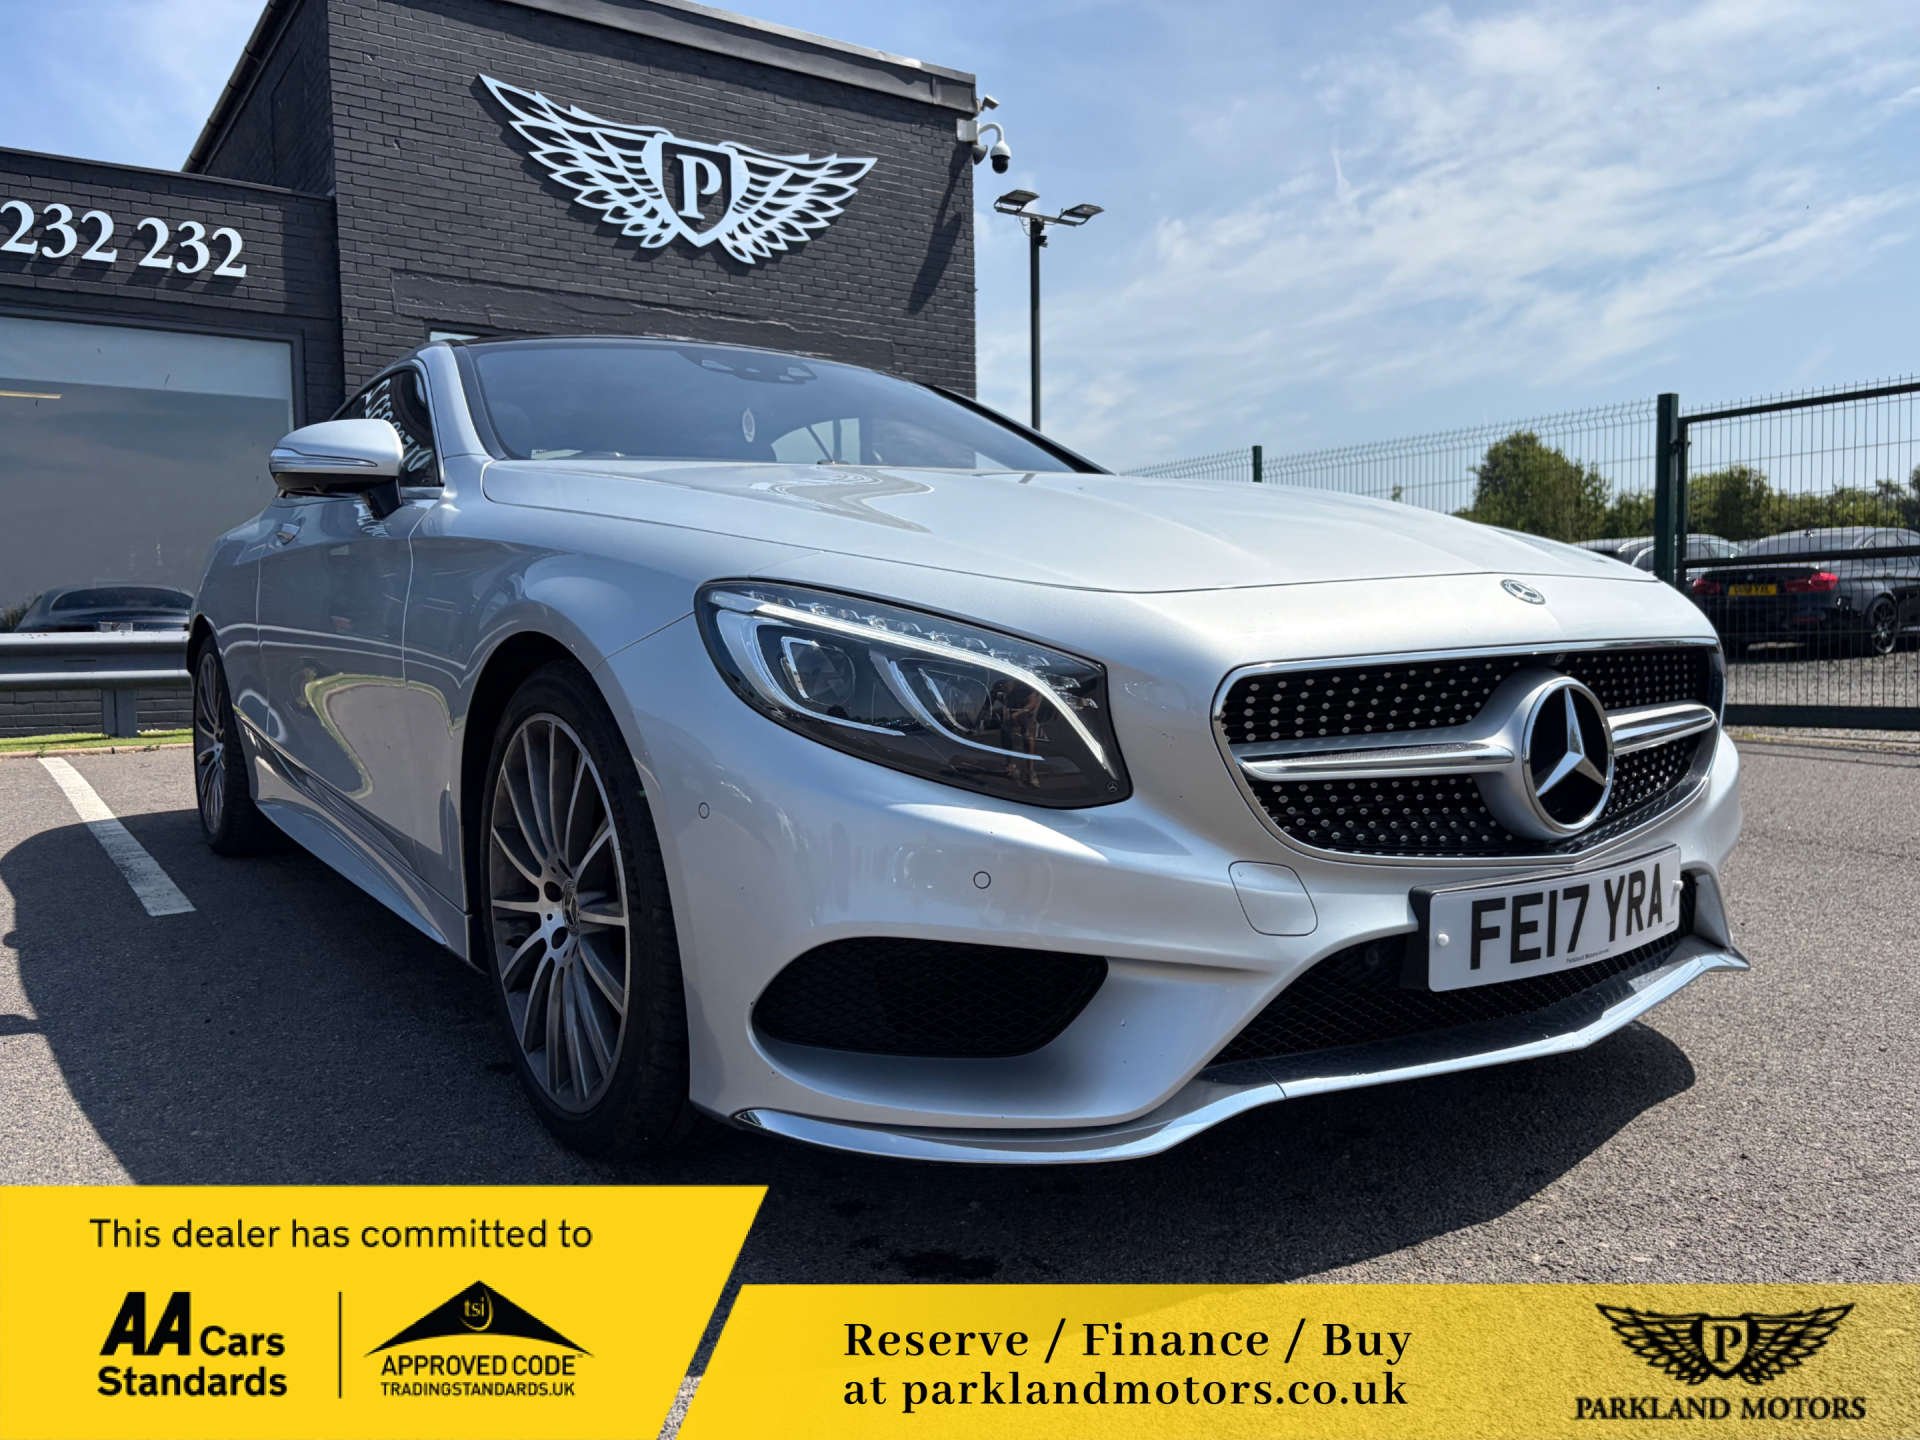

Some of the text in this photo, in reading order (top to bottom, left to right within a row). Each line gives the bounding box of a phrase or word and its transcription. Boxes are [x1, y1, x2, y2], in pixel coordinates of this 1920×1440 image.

[676, 153, 723, 219] P
[0, 200, 247, 278] 232 232
[1470, 863, 1663, 970] FE17 YRA
